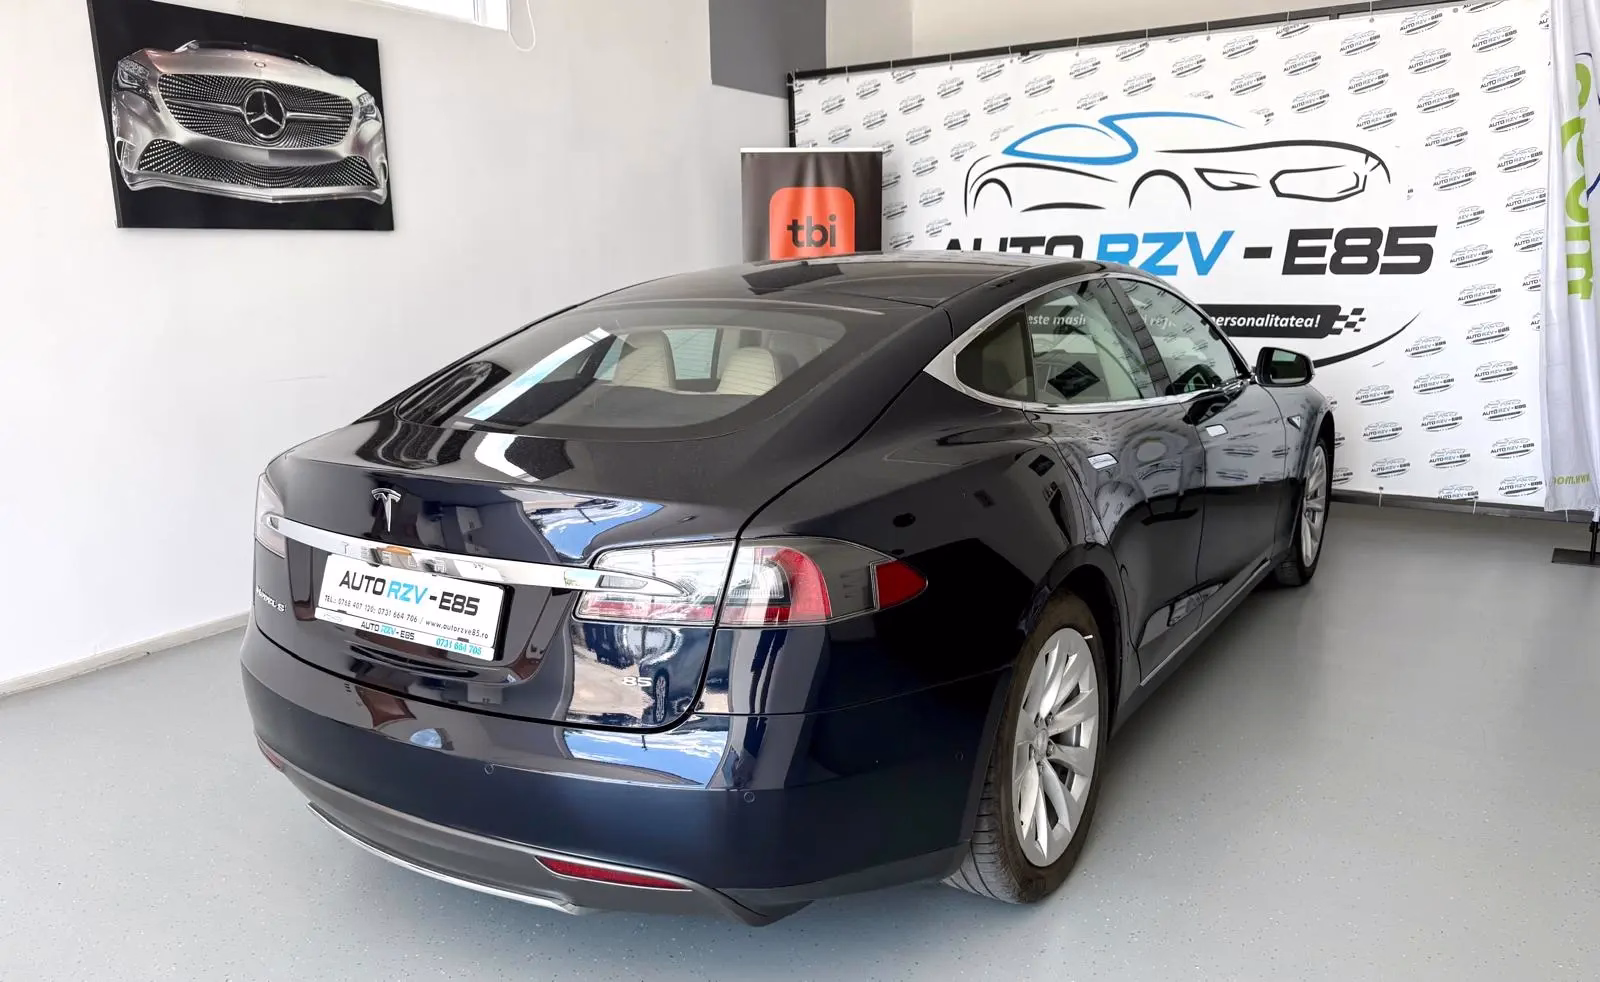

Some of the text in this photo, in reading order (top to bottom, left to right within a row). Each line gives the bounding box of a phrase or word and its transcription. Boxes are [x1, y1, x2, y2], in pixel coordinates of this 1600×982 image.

[1400, 23, 1415, 31] AUTO
[1340, 44, 1354, 52] AUTO
[1472, 40, 1487, 48] AUTO
[1348, 82, 1362, 90] AUTO
[1480, 80, 1496, 89] AUTO
[1356, 120, 1370, 128] AUTO
[1489, 120, 1505, 128] AUTO
[1497, 159, 1513, 168] AUTO
[1505, 199, 1522, 208] AUTO
[786, 214, 836, 248] tbi
[1096, 230, 1235, 276] RZV
[1282, 225, 1438, 275] E85
[339, 570, 386, 596] AUTO
[387, 580, 428, 604] RZV
[439, 591, 480, 616] E85
[378, 607, 392, 616] 0731
[406, 614, 417, 623] 706
[361, 621, 380, 632] AUTO
[381, 624, 396, 635] RZV
[622, 676, 652, 687] 85
